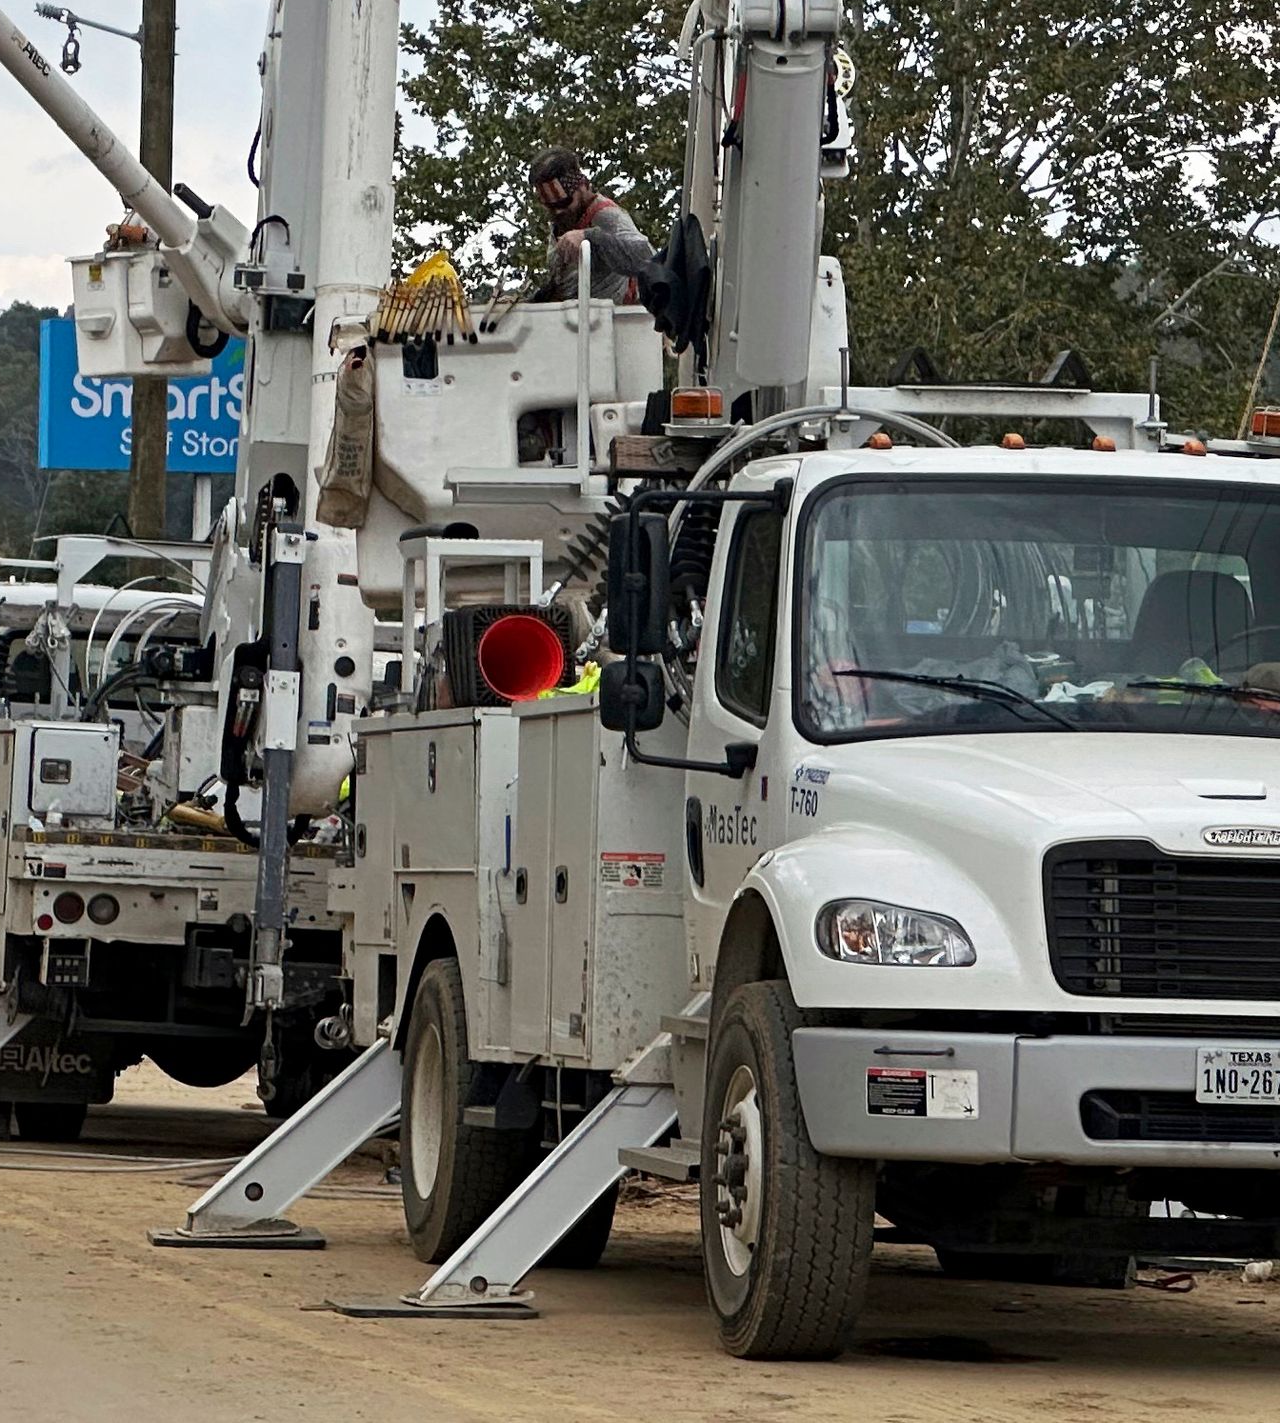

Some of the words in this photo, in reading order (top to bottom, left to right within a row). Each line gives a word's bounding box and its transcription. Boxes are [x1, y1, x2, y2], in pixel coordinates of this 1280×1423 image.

[22, 41, 51, 76] Altec
[791, 786, 818, 817] T-760
[709, 804, 757, 846] MasTec
[25, 1046, 92, 1074] Altec
[1230, 1051, 1271, 1063] TEXAS
